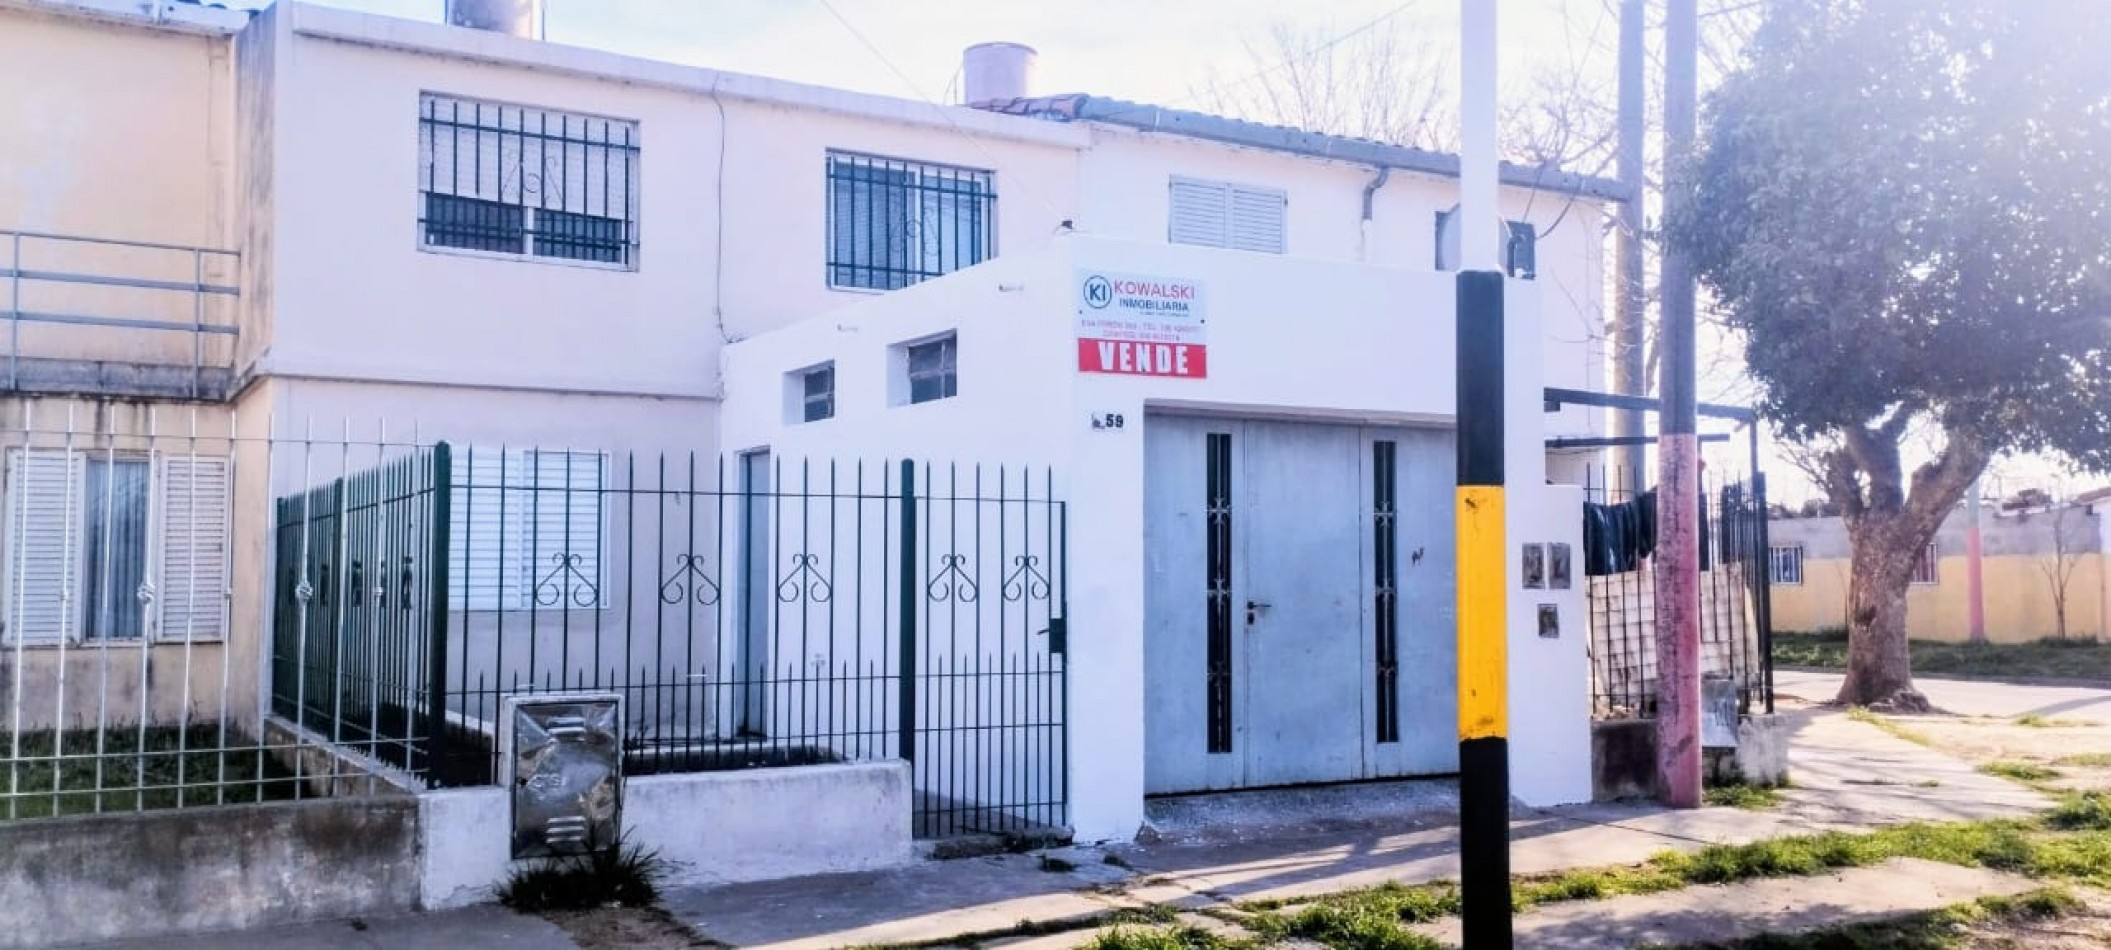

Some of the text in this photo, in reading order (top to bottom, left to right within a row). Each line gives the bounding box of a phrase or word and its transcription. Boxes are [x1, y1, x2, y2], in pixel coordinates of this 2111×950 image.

[1089, 283, 1106, 301] KI
[1114, 280, 1195, 299] KOWALSKI
[1119, 297, 1189, 312] INMOBILIARIA
[1097, 341, 1189, 374] VENDE
